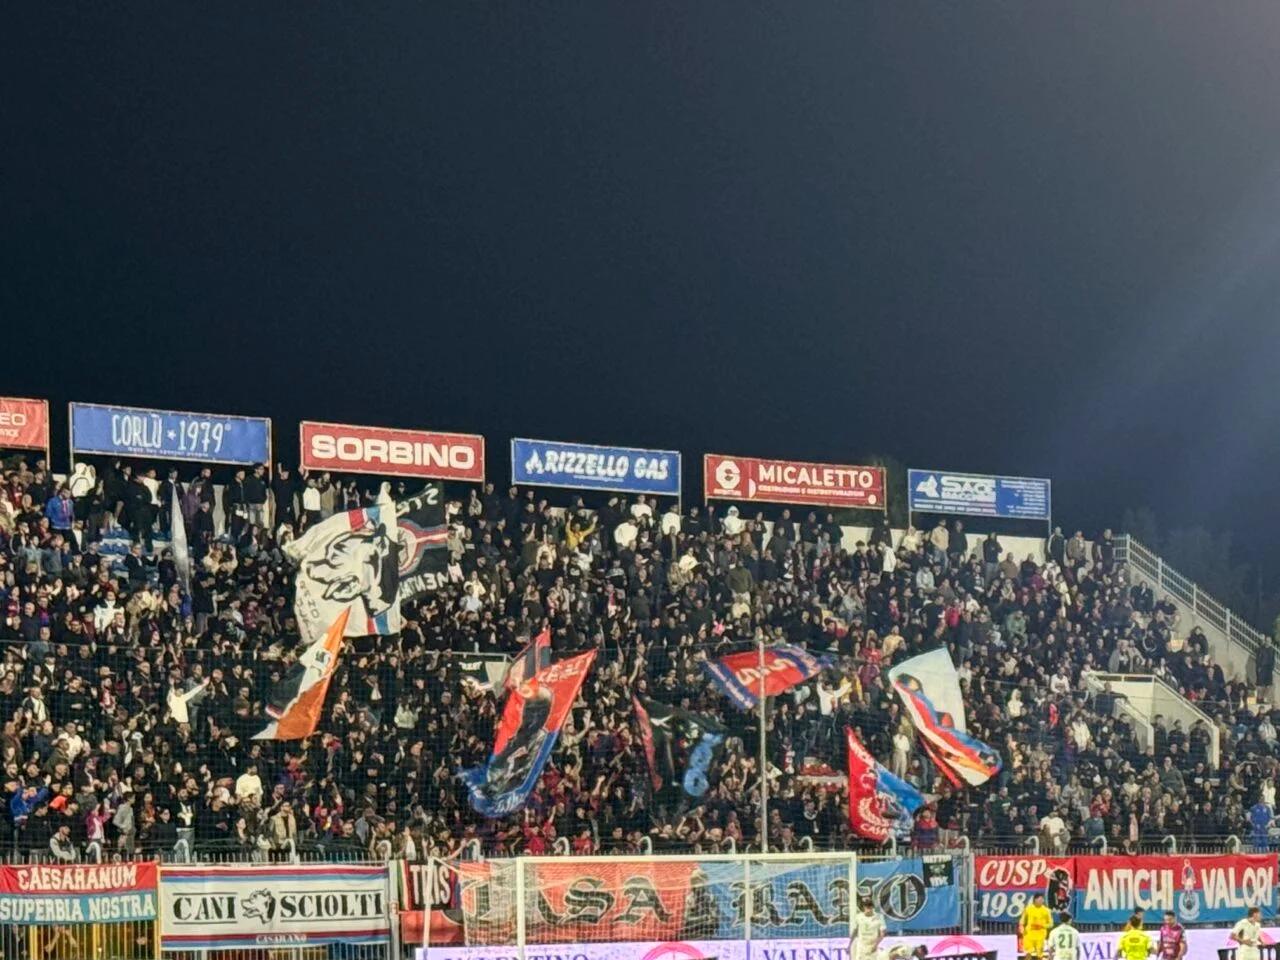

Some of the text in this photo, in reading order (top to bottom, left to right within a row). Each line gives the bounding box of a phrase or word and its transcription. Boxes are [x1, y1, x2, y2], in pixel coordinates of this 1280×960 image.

[311, 434, 475, 470] SORBINO
[634, 457, 669, 480] GAS
[758, 464, 873, 488] MICALETTO
[17, 865, 138, 890] CAESARANUM
[1084, 866, 1274, 910] ANTICHI VALORI
[0, 894, 157, 921] SUPERBIA NOSTRA
[173, 892, 384, 920] CANI SCIOLTI
[981, 892, 1030, 917] 198
[1058, 934, 1073, 948] 21
